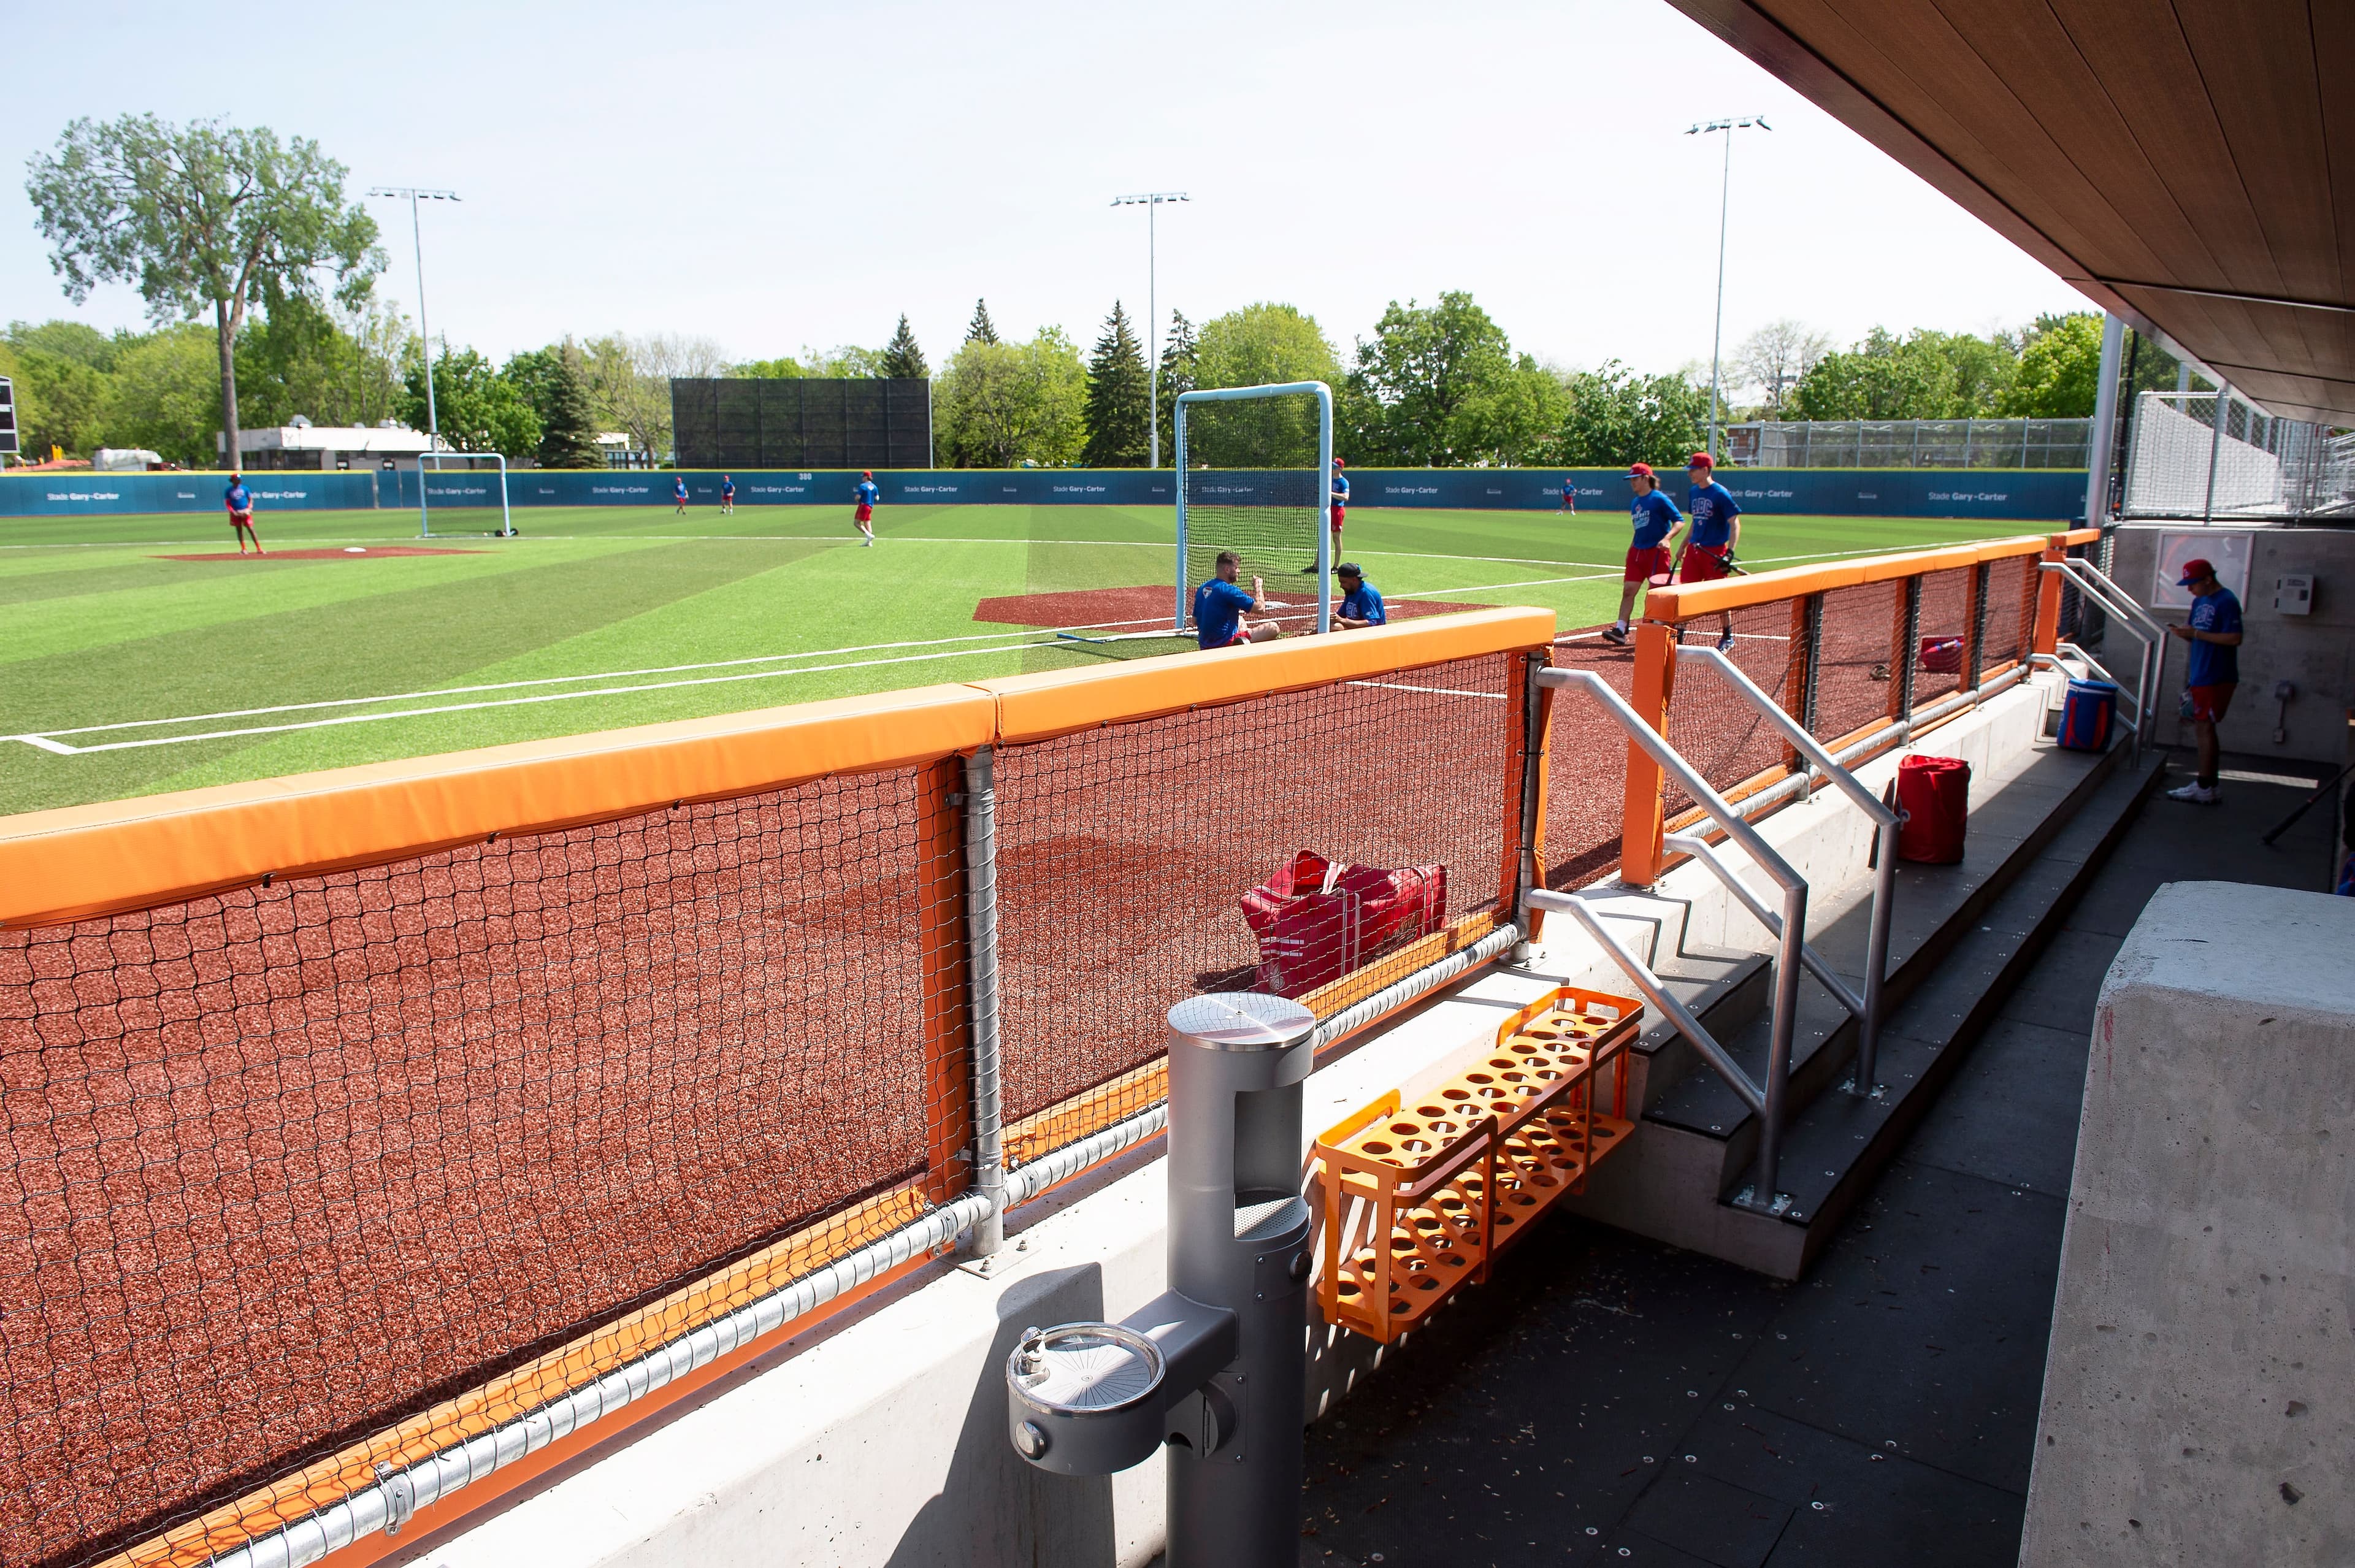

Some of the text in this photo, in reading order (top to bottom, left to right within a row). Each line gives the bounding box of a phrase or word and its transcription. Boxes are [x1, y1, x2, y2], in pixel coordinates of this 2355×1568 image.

[1744, 490, 1793, 499] Gary-Carter
[1951, 493, 2007, 502] Gary-Carter
[1691, 497, 1713, 516] ABC
